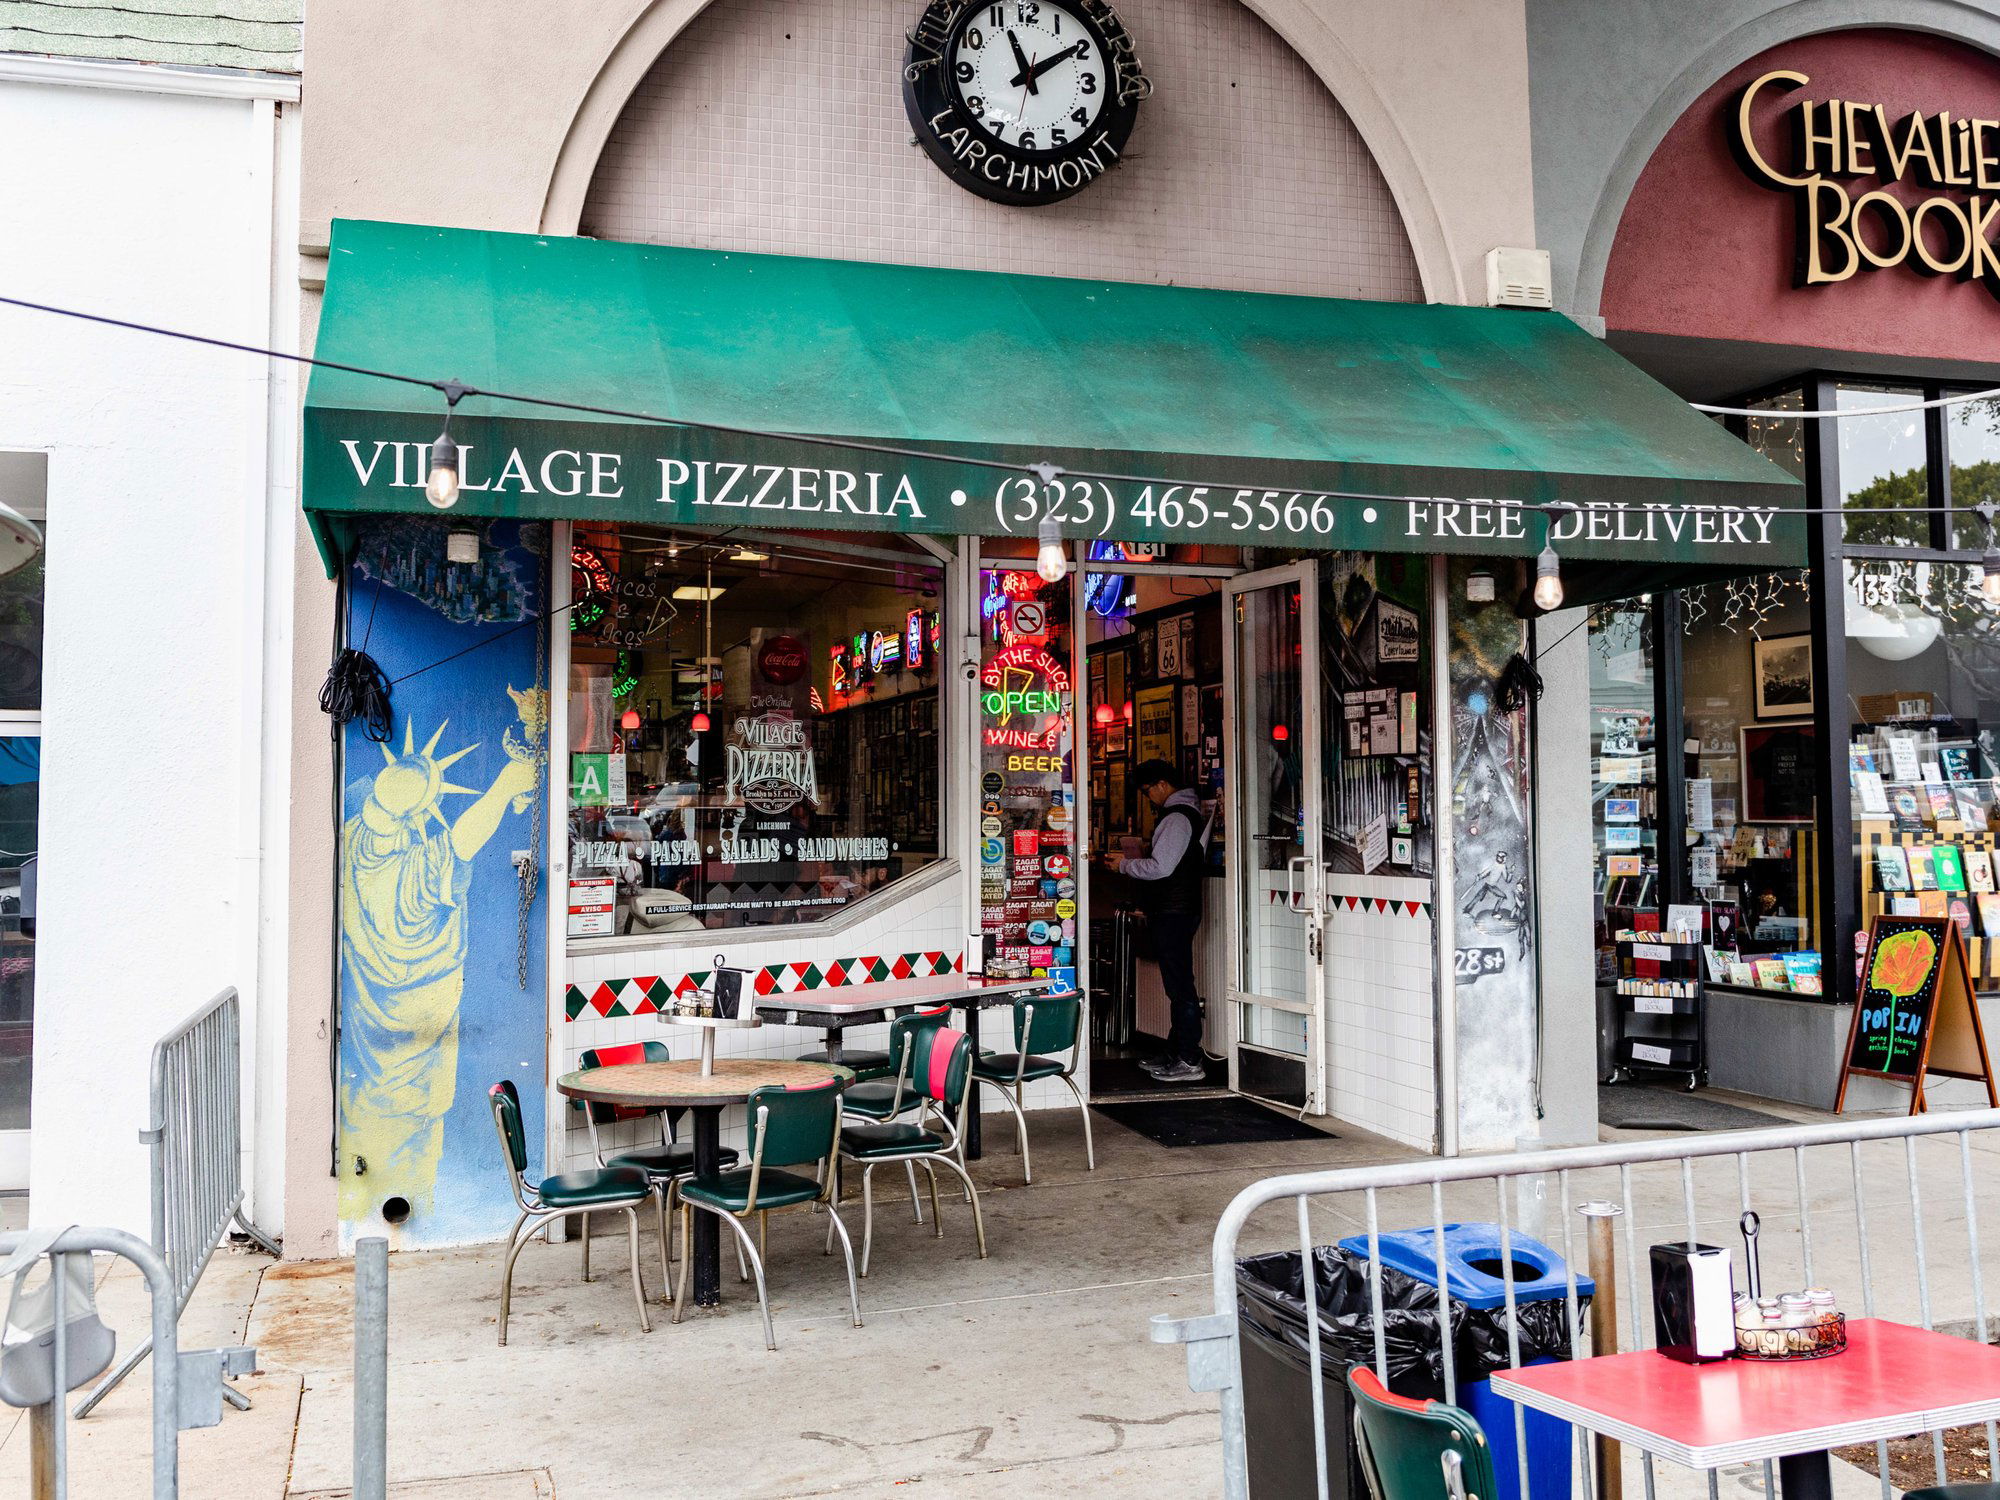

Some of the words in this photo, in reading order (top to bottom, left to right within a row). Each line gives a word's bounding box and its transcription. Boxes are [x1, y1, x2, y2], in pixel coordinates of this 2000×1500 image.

[990, 6, 1004, 27] 11
[1018, 3, 1040, 24] 12
[1054, 14, 1060, 34] 1
[962, 28, 983, 50] 10
[1076, 39, 1090, 60] 2
[956, 61, 975, 84] 9
[1080, 72, 1097, 94] 3
[967, 96, 985, 119] 8
[1070, 107, 1089, 127] 4
[989, 121, 1005, 140] 7
[1018, 131, 1036, 149] 6
[1051, 129, 1068, 149] 5
[930, 108, 1119, 192] LARCHMONT
[339, 440, 624, 498] VILLAGE
[656, 458, 927, 518] PIZZERIA
[995, 476, 1115, 537] (323)
[1130, 485, 1335, 534] 465-5566
[1404, 497, 1526, 539] FREE
[1551, 504, 1778, 544] DELIVERY
[1852, 566, 1894, 606] 133
[985, 662, 1002, 687] BY
[999, 649, 1033, 667] THE
[1036, 652, 1070, 691] SLICE
[1163, 650, 1175, 670] 66
[612, 676, 639, 699] SLICE
[987, 691, 1060, 715] OPEN
[735, 716, 806, 747] VILLAGE
[988, 730, 1039, 749] WINE
[724, 743, 821, 806] PIZZERIA
[1008, 755, 1063, 772] BEER
[580, 766, 602, 796] A
[756, 821, 791, 831] LARCHMONT
[572, 841, 629, 867] PIZZA
[650, 839, 702, 866] PASTA
[720, 838, 781, 864] SALADS
[797, 837, 889, 862] SANDWICHES
[730, 901, 751, 910] PLEASE
[751, 901, 764, 909] WAIT
[764, 900, 773, 908] TO
[774, 900, 782, 908] BE
[811, 897, 833, 906] OUTSIDE
[833, 897, 846, 905] FOOD
[1862, 1007, 1891, 1033] POP
[1894, 1012, 1921, 1036] IN
